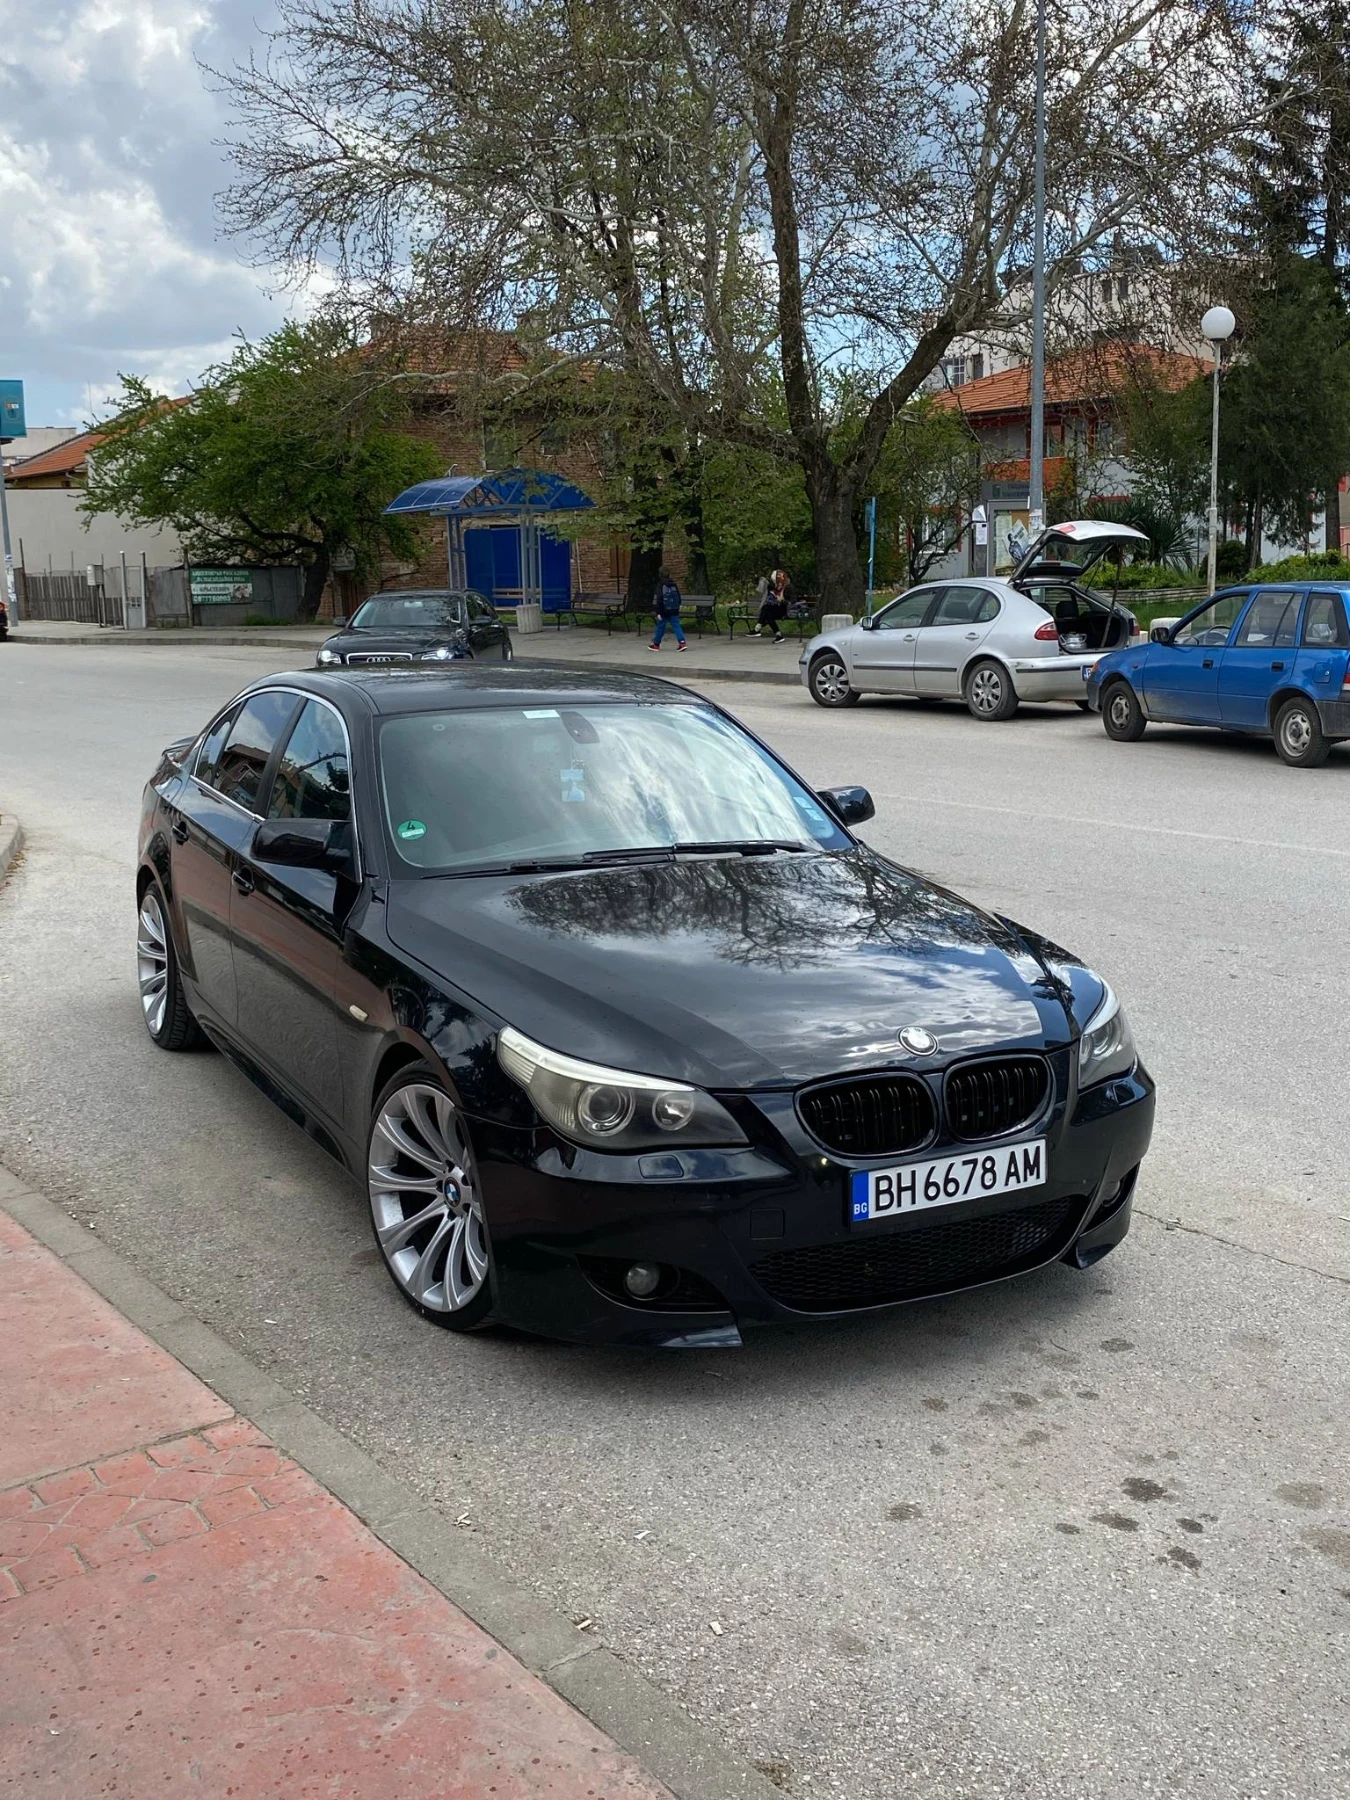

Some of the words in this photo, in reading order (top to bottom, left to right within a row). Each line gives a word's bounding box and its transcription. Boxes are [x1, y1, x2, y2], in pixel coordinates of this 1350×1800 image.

[407, 821, 416, 830] 4
[875, 1170, 916, 1212] BH
[924, 1156, 997, 1201] 6678
[1004, 1145, 1041, 1187] AM
[854, 1202, 868, 1215] BG
